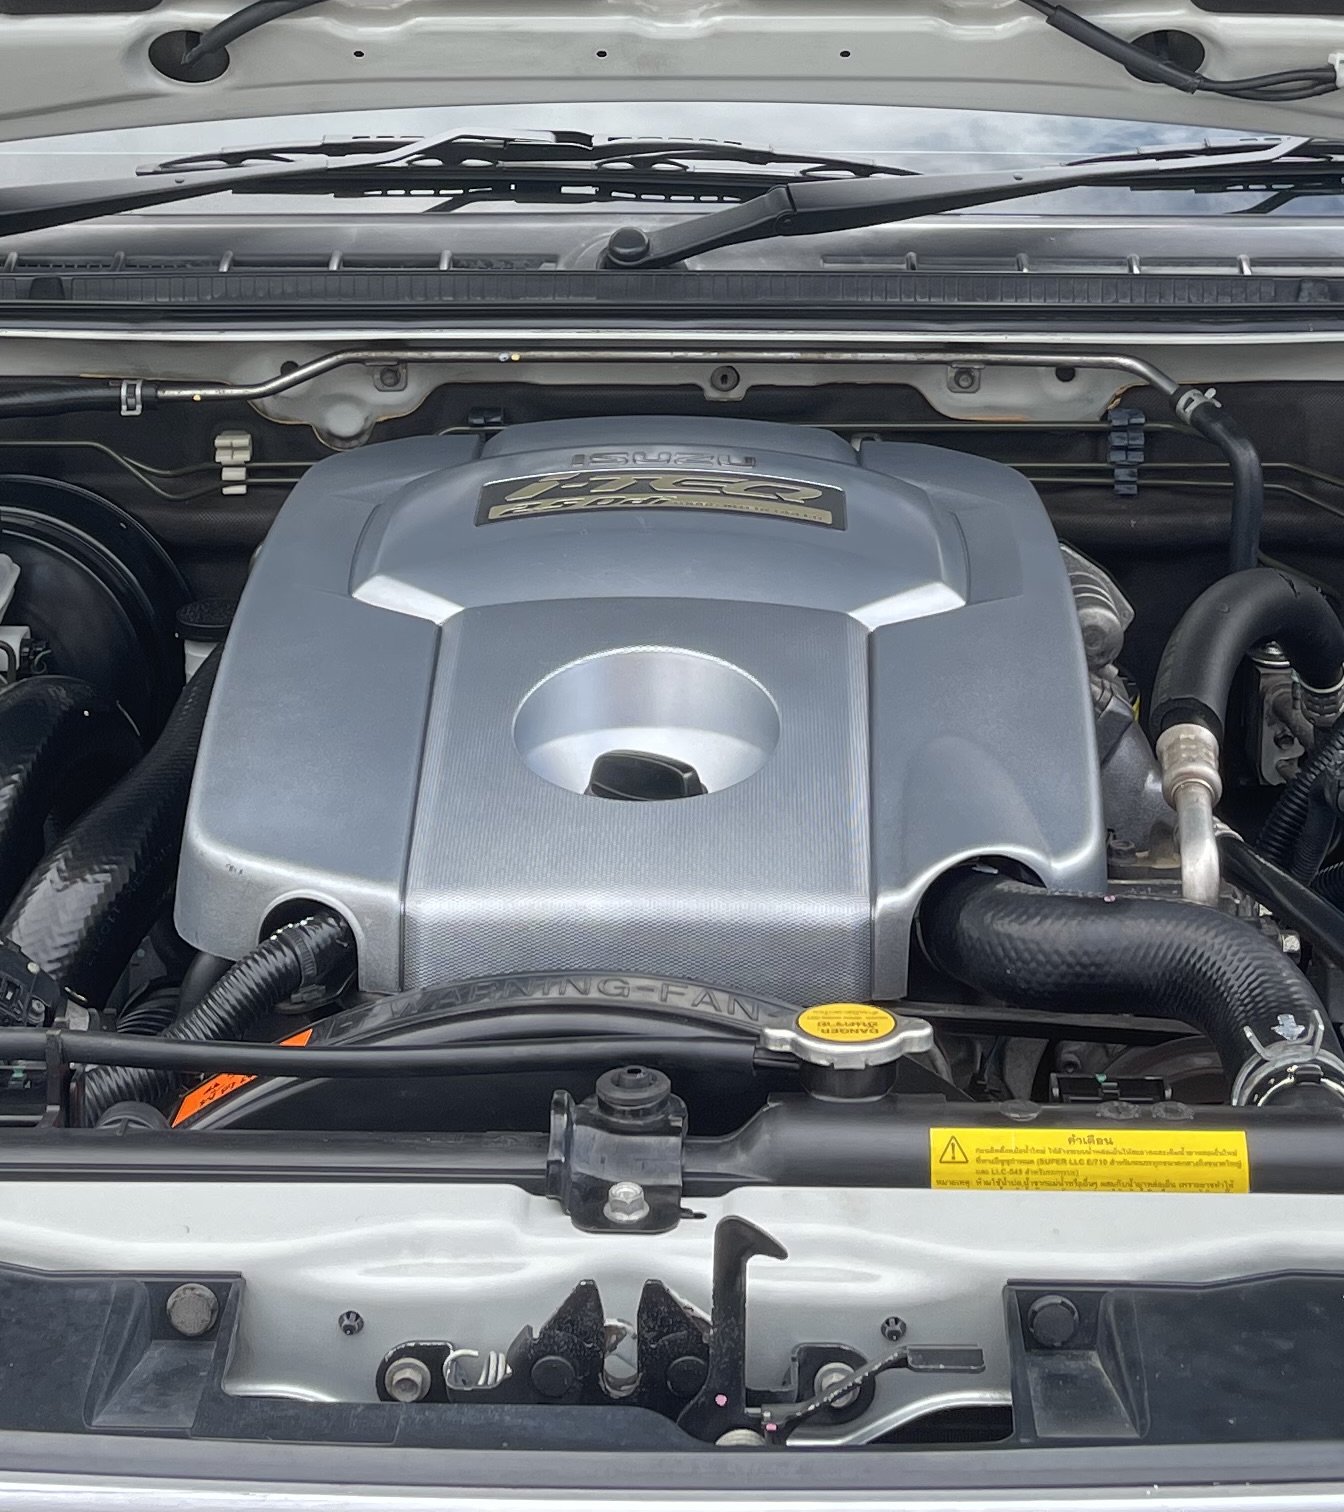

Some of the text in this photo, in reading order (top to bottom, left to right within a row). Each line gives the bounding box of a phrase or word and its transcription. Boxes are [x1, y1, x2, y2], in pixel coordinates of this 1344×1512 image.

[570, 451, 756, 469] ISUZU
[1067, 1134, 1114, 1146] คำเตือน
